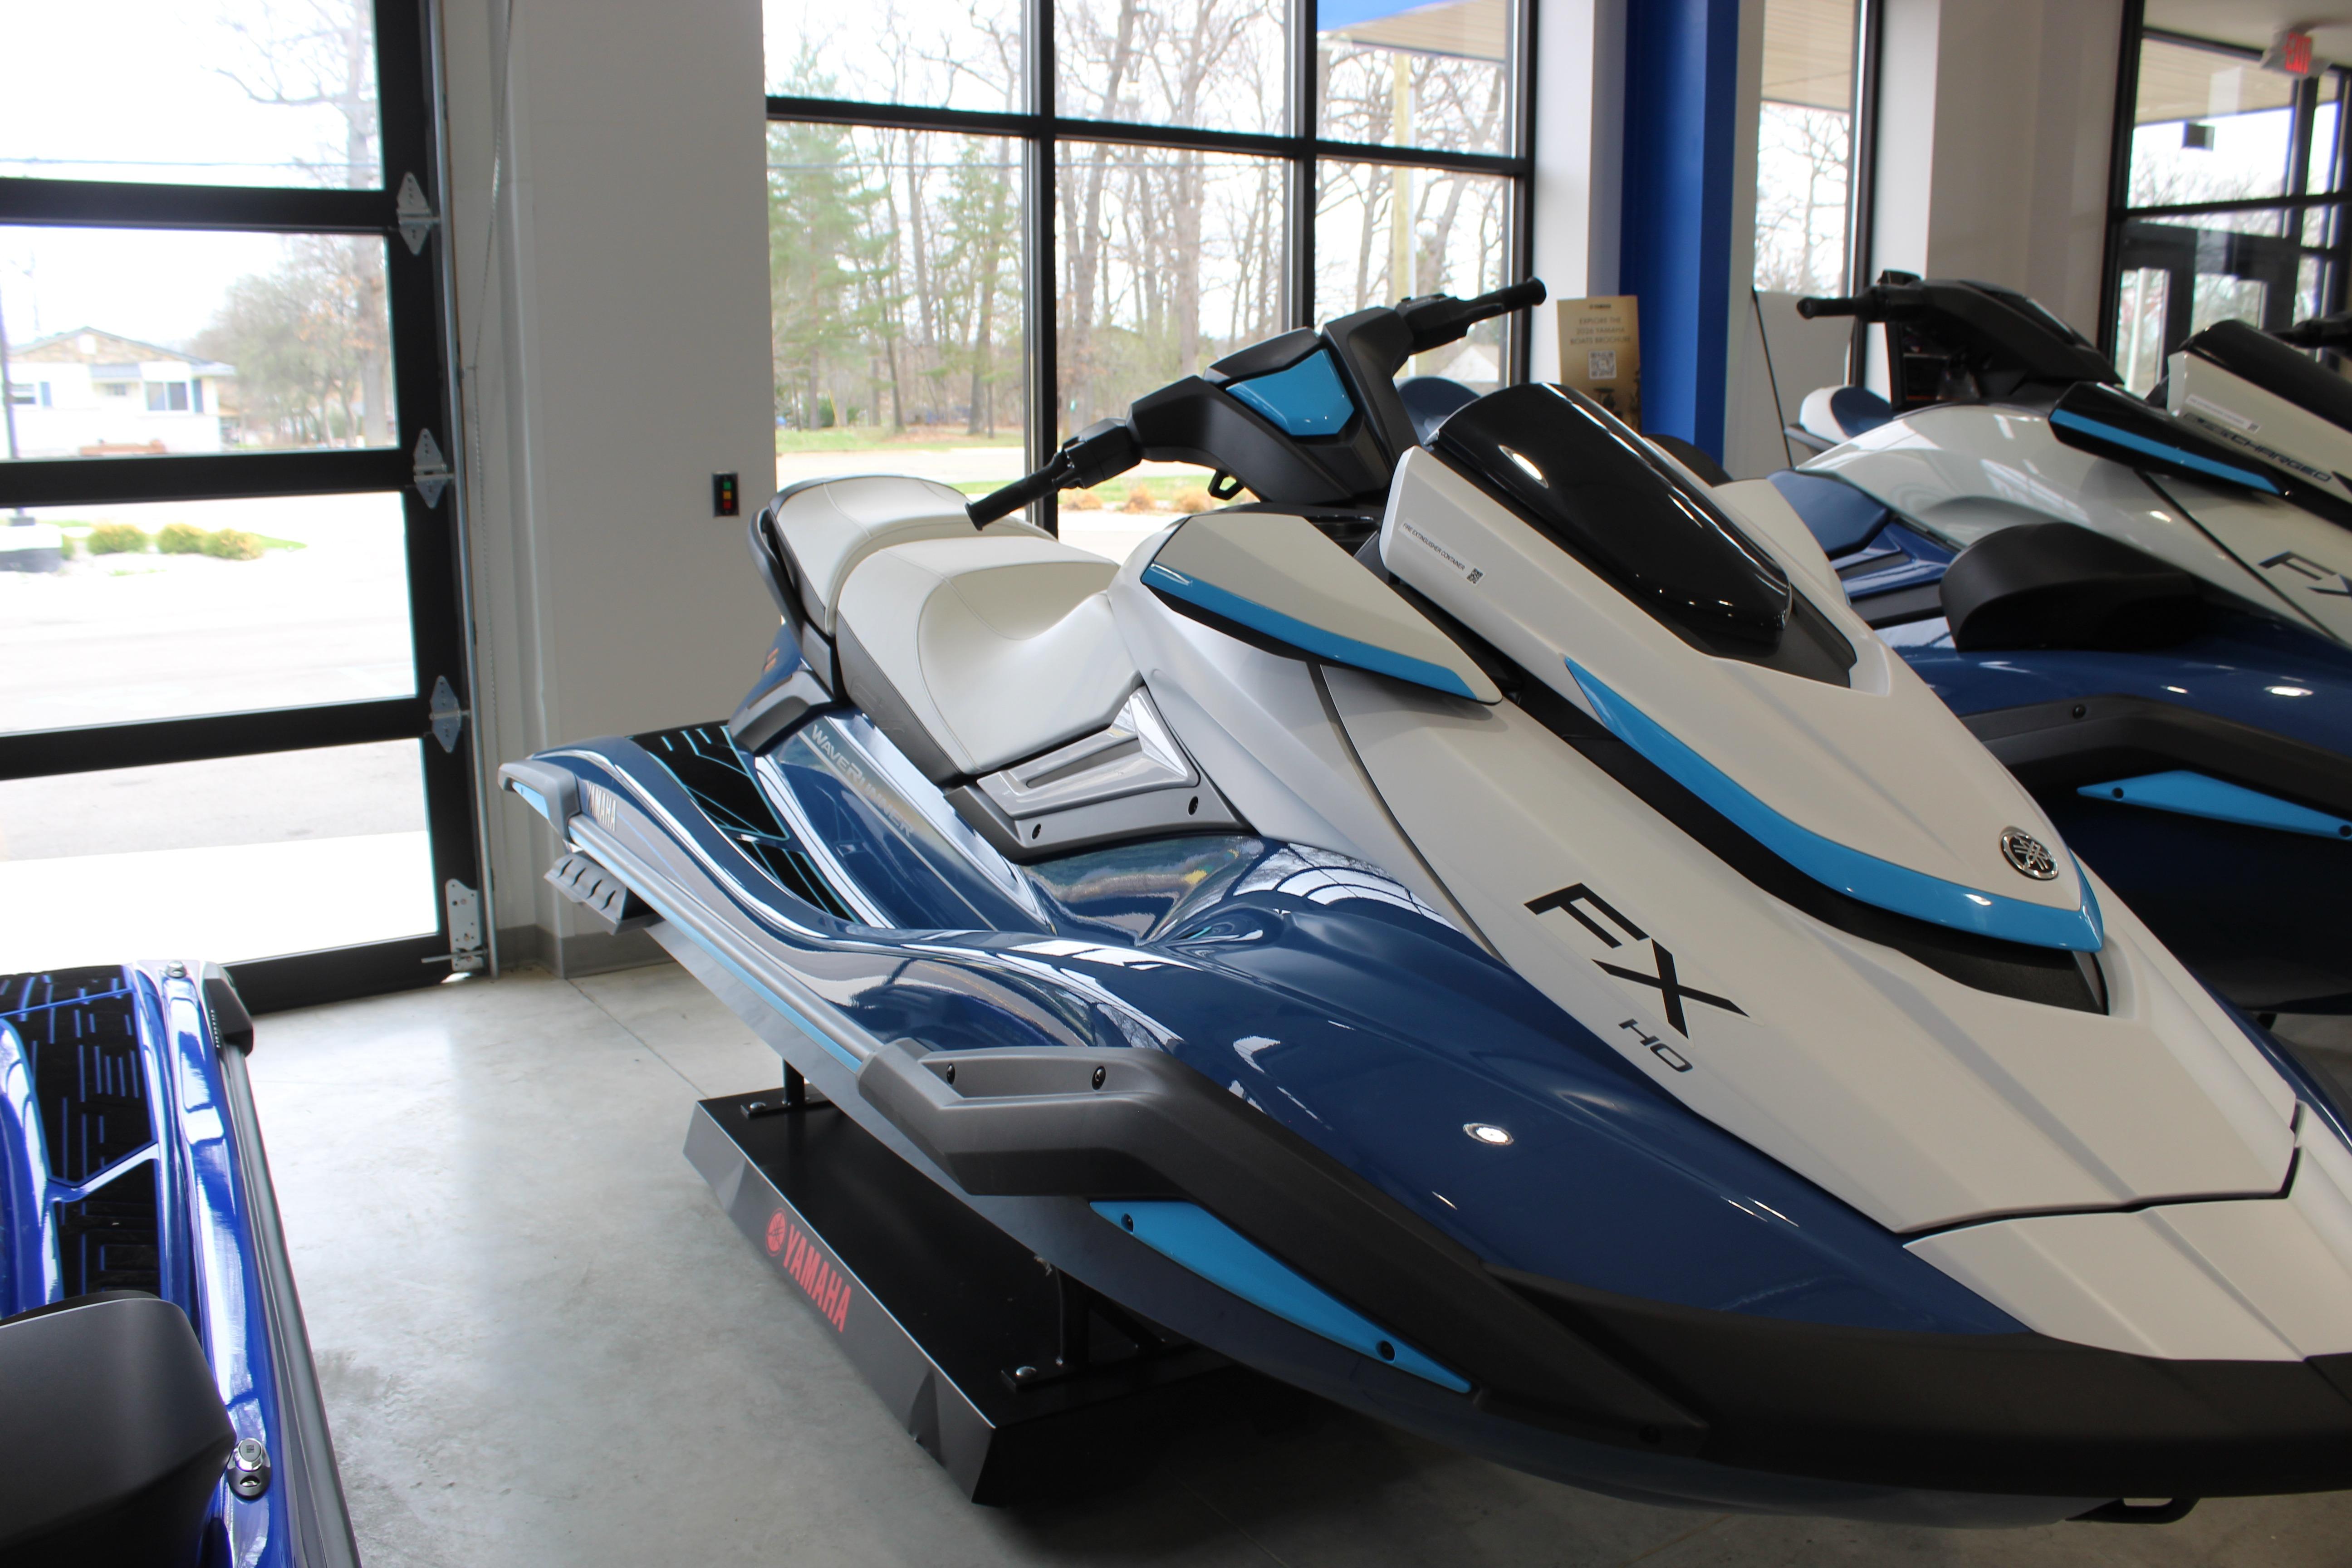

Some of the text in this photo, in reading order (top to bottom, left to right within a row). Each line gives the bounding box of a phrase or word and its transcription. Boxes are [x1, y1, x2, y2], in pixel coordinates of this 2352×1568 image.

[1403, 523, 1465, 570] FIRE EXTINGUISHER CONTAINER
[811, 725, 914, 838] WAVERUNNER
[1523, 882, 1750, 1039] FX
[1618, 1018, 1693, 1073] HO
[783, 1223, 852, 1333] YAMAHA
